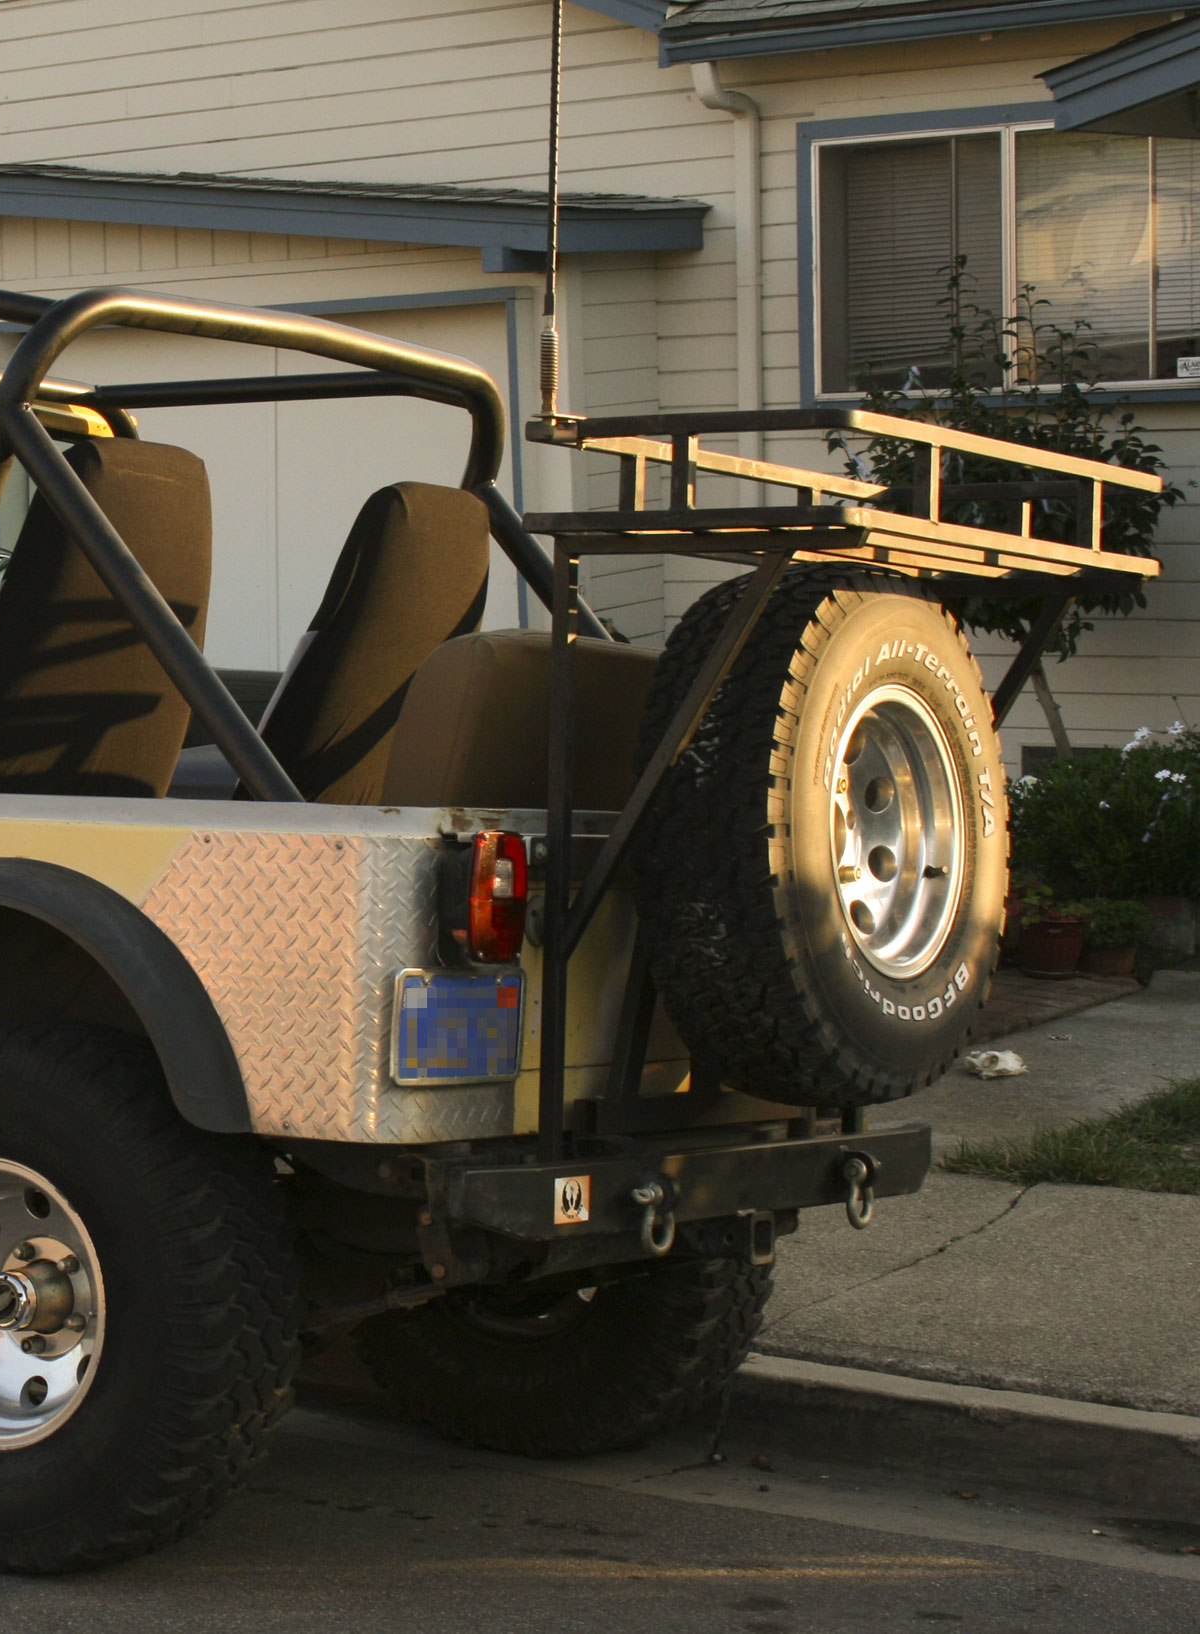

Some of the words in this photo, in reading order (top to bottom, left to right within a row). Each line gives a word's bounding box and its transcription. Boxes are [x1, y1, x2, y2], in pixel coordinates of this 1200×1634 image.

[823, 655, 871, 792] Radial
[875, 639, 982, 757] All-Terrain
[978, 766, 995, 838] T/A
